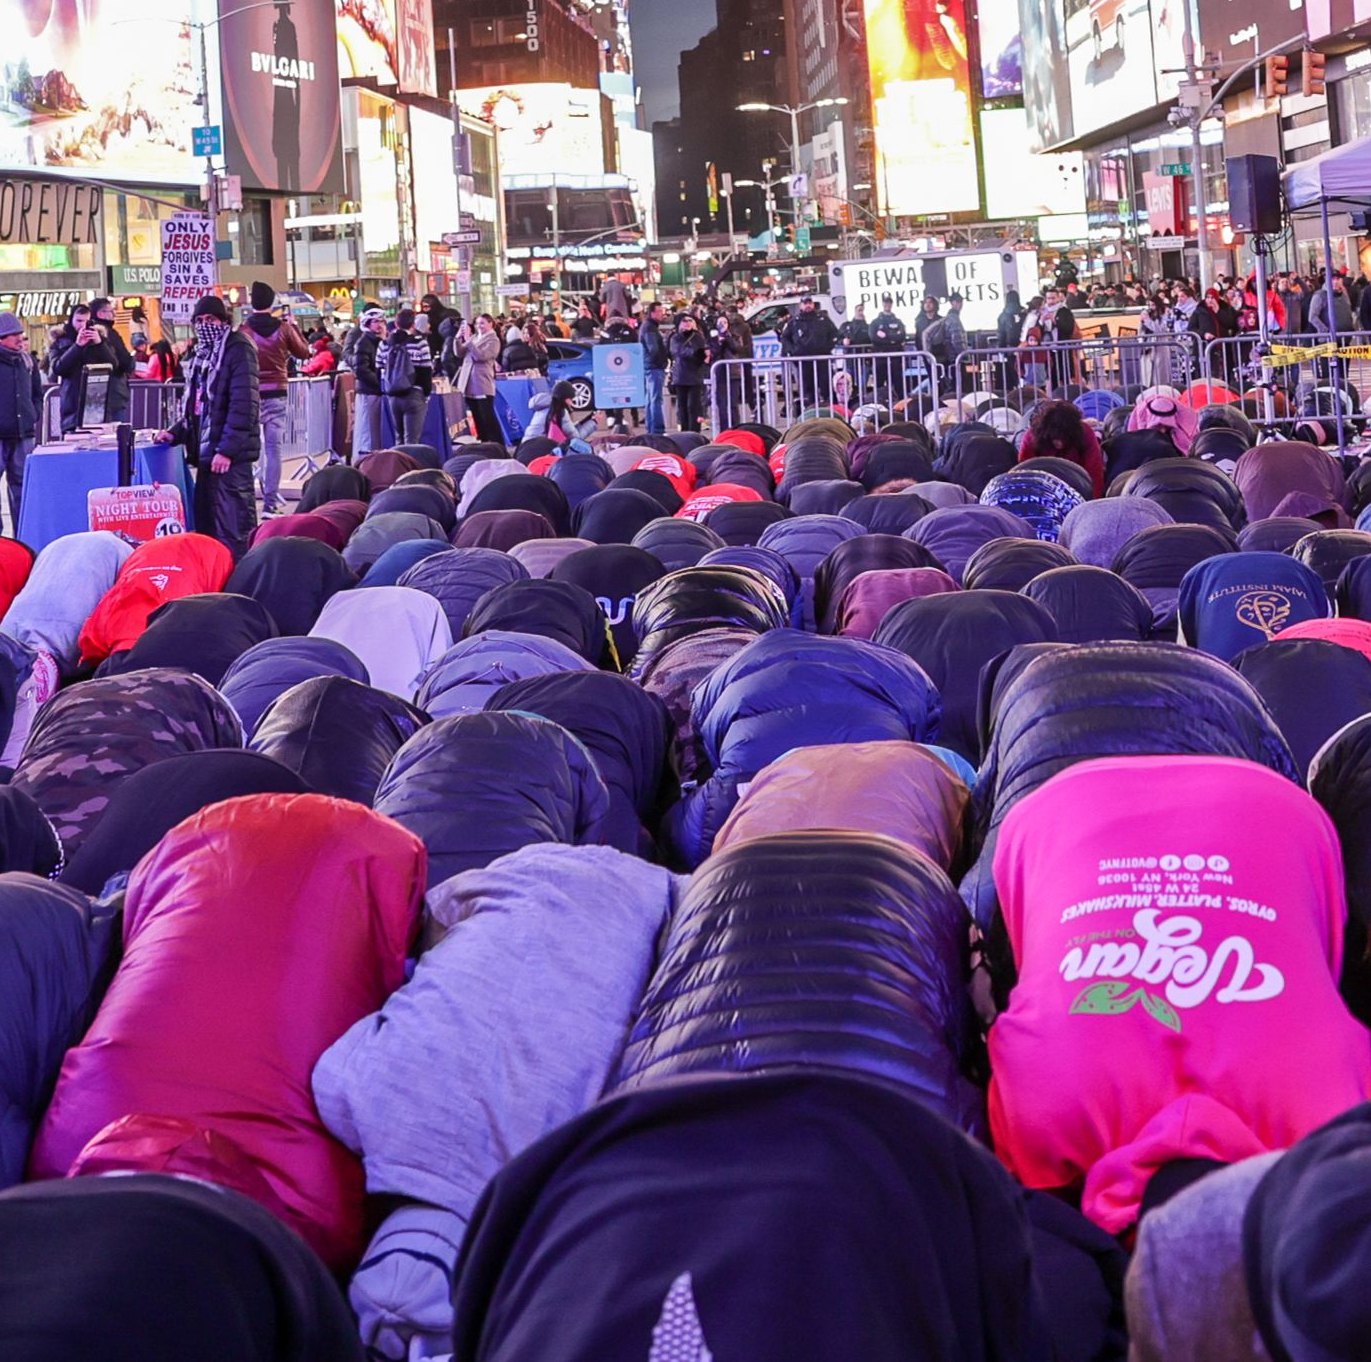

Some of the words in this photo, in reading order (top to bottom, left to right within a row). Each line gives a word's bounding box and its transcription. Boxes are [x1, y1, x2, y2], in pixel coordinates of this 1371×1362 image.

[251, 51, 315, 81] BVLGARI
[165, 222, 210, 233] ONLY
[164, 233, 210, 250] JESUS
[162, 251, 214, 264] FORGIVES
[169, 264, 191, 274] SIN
[196, 264, 204, 274] &
[955, 261, 978, 281] OF
[123, 268, 137, 283] U.S.
[138, 268, 161, 283] POLO
[164, 275, 210, 285] SAVES
[163, 286, 213, 299] REPENT
[16, 293, 68, 317] FOREVER
[162, 303, 176, 313] END
[181, 303, 189, 312] IS
[116, 490, 156, 500] TOPVIEW
[95, 501, 138, 518] NIGHT
[142, 500, 179, 513] TOUR
[1098, 873, 1136, 885] 10036
[1142, 873, 1161, 882] NY
[1203, 874, 1233, 885] New
[1166, 884, 1180, 892] W
[1183, 884, 1199, 892] 24
[1060, 894, 1153, 924] MILKSHAKES
[1059, 908, 1285, 1009] Vegan
